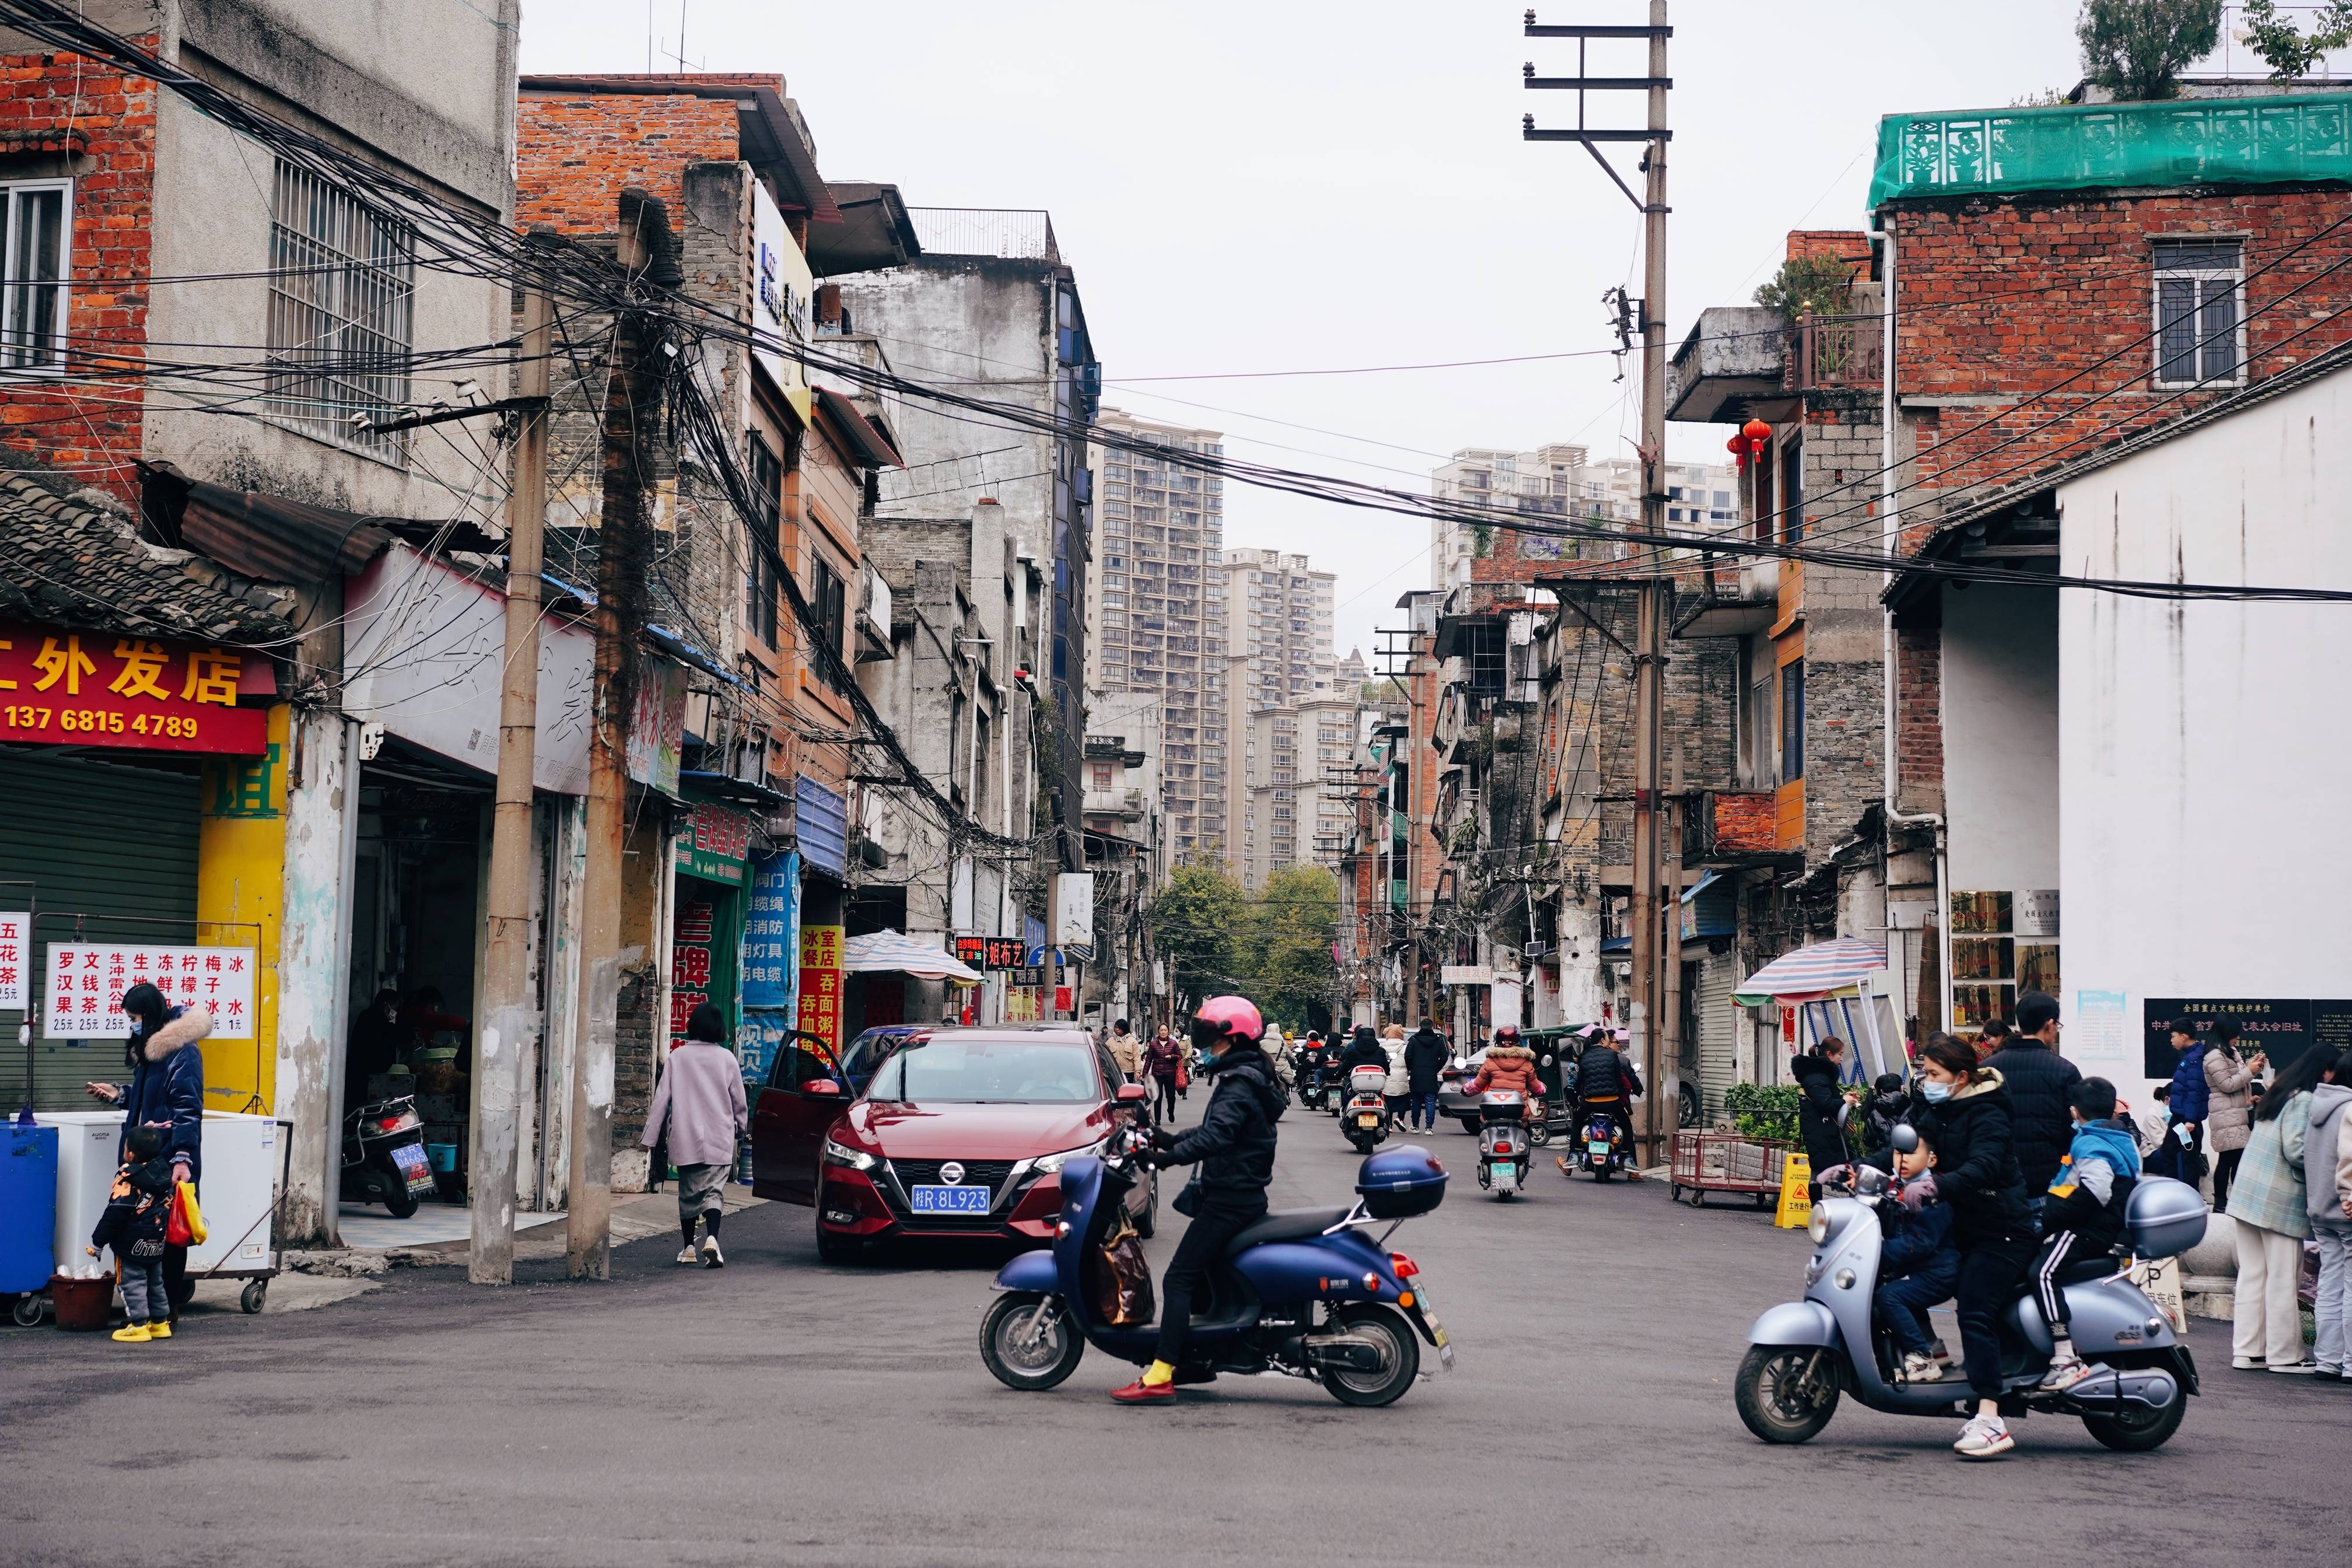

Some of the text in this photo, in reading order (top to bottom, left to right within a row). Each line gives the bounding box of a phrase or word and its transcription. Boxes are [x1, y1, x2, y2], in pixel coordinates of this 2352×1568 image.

[5, 706, 198, 739] 137 6815 4789
[750, 872, 785, 888] 阀门
[803, 930, 836, 947] 冰室
[803, 949, 835, 967] 餐店
[56, 951, 75, 1014] 罗汉果
[82, 951, 100, 1014] 文钱茶
[205, 955, 222, 1016] 梅子冰
[2183, 1003, 2272, 1013] 全国重点文物保护单位
[54, 1019, 73, 1030] 2.5元
[79, 1019, 99, 1030] 2.5元
[106, 1019, 124, 1030] 2.5元
[229, 1020, 242, 1030] 1元
[397, 1152, 426, 1168] 04665
[2147, 1268, 2161, 1289] P
